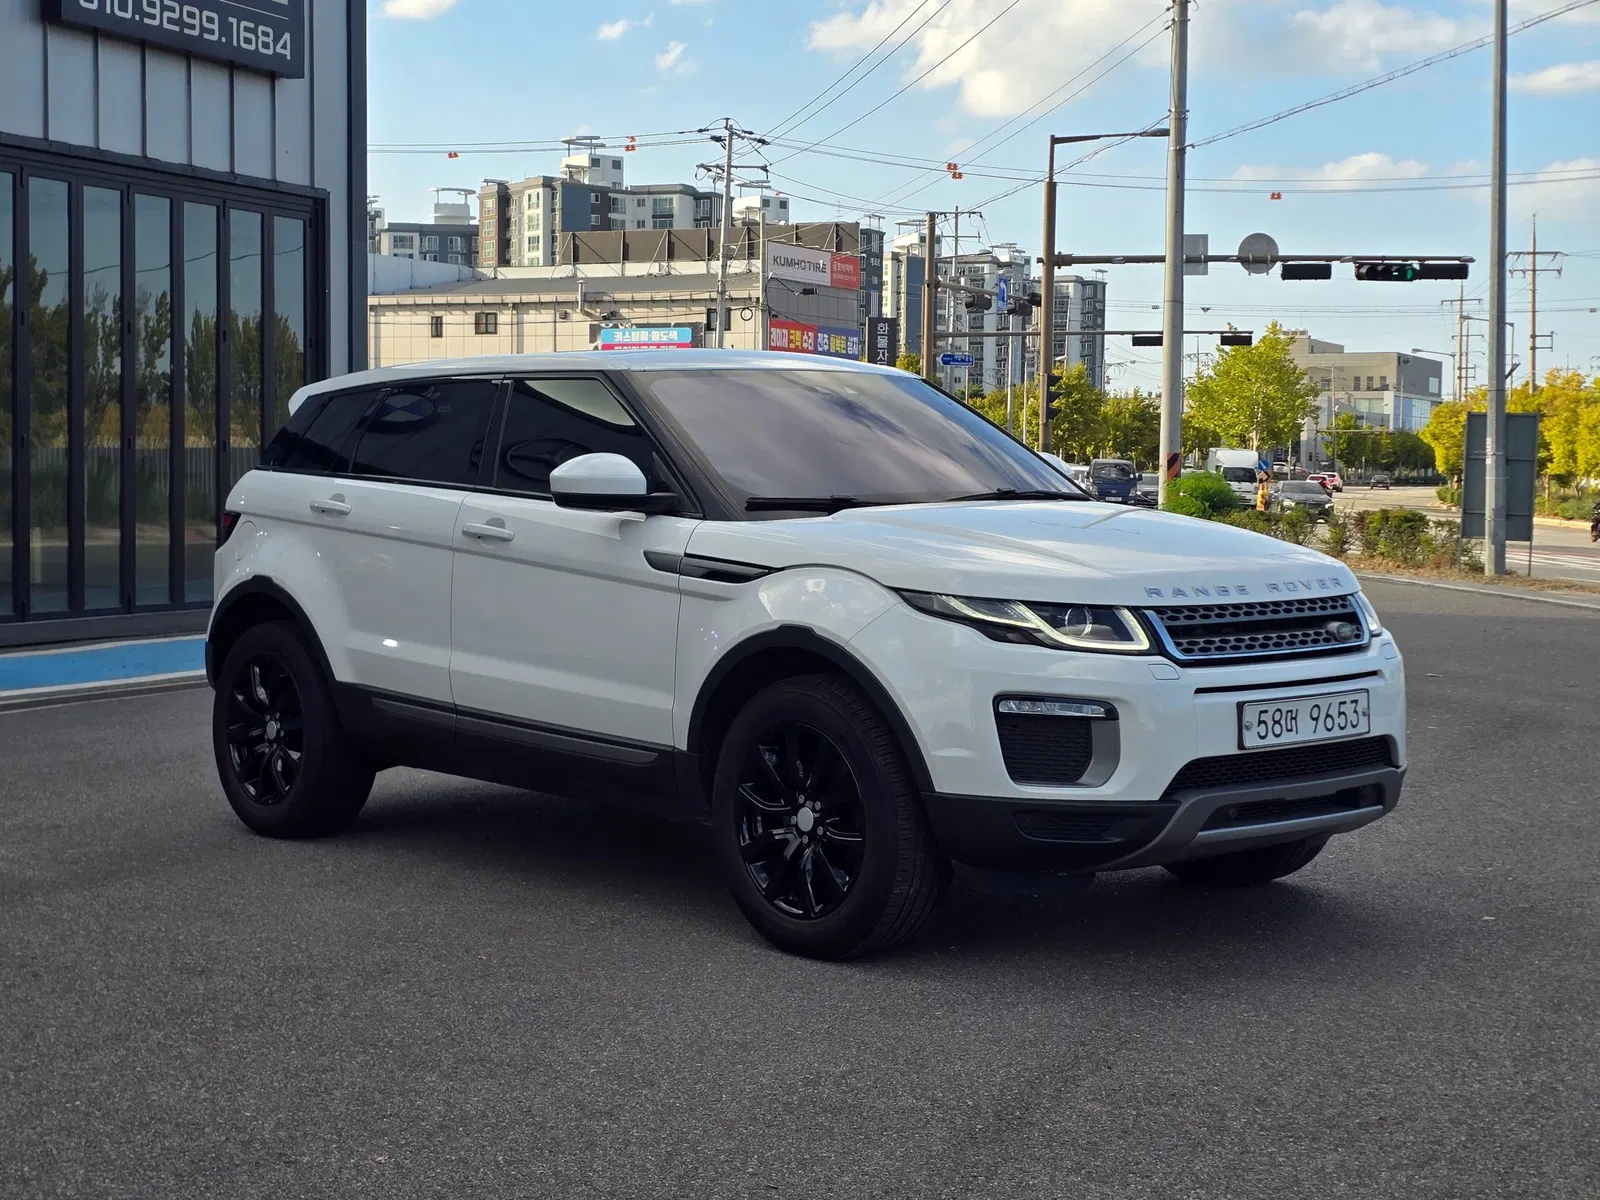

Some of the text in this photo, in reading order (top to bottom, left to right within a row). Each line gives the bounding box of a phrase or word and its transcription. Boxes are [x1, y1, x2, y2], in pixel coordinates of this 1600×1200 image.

[773, 255, 827, 273] KUMHO TIRE
[802, 330, 814, 350] 수리
[876, 322, 889, 366] 화물자
[1144, 576, 1345, 599] RANGE ROVER
[1256, 698, 1360, 741] 58머 9653
